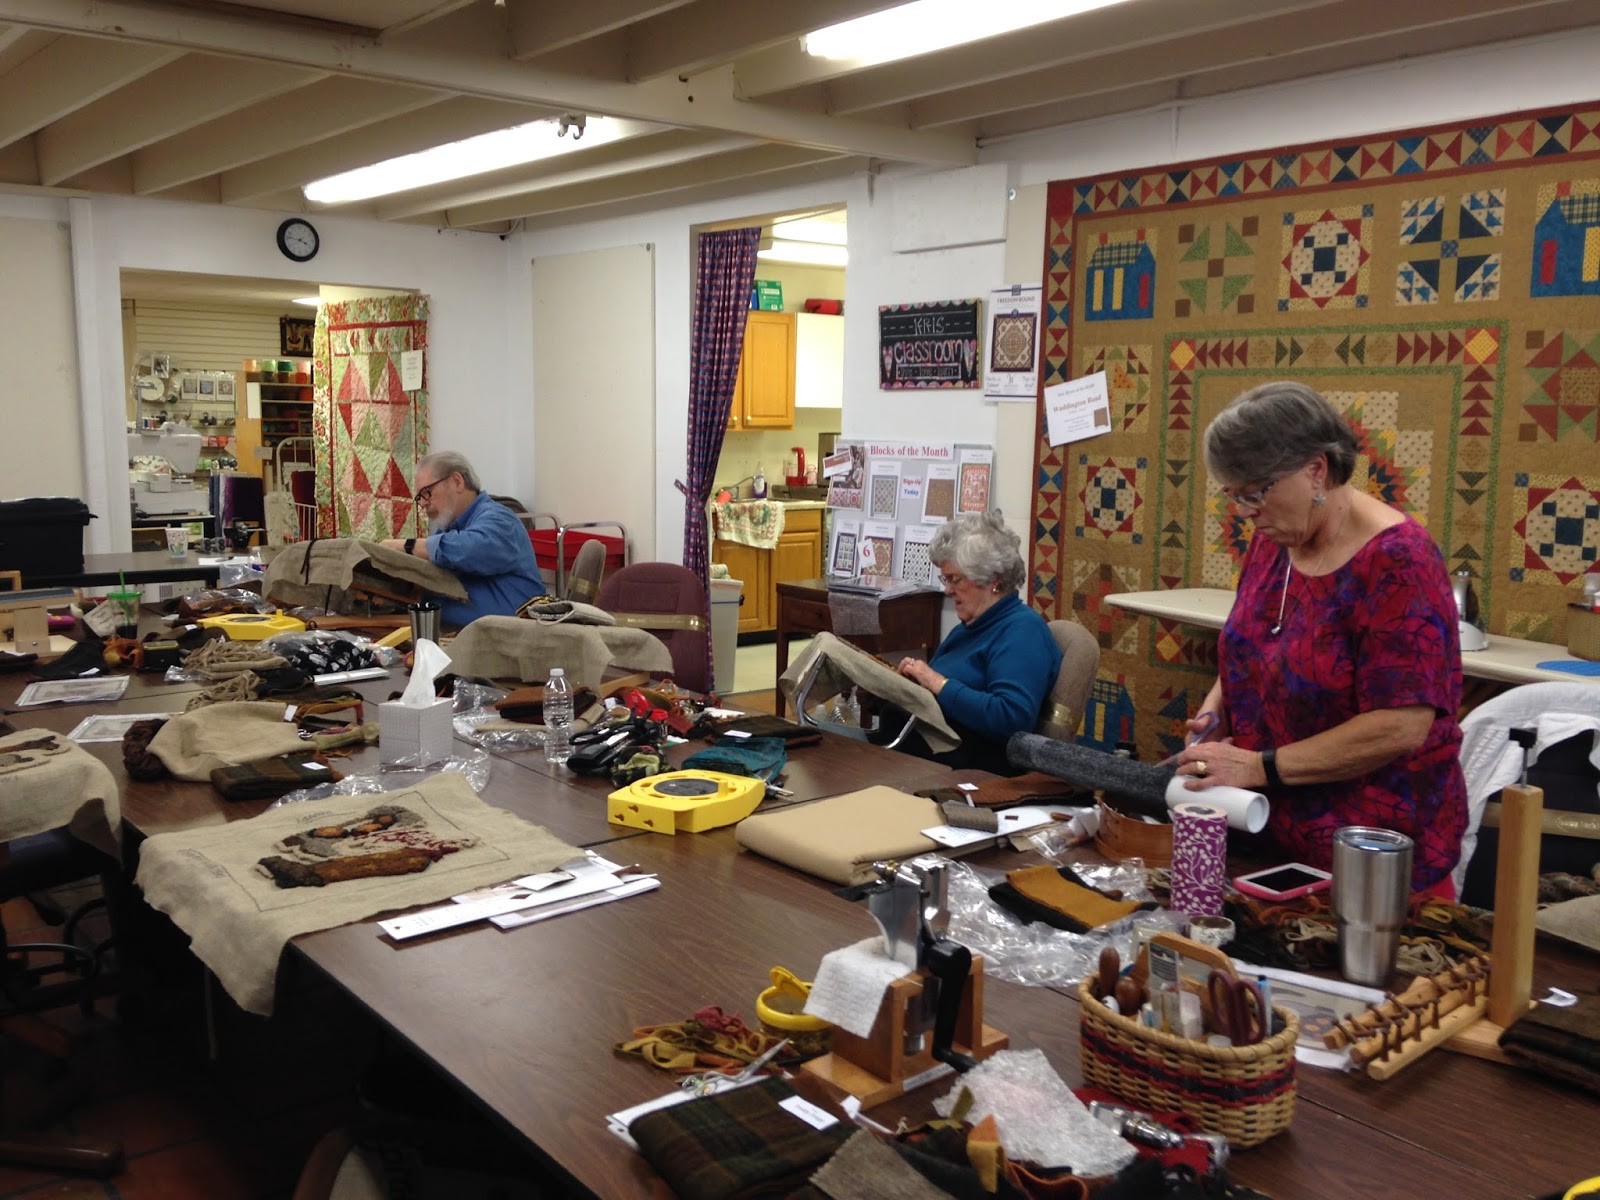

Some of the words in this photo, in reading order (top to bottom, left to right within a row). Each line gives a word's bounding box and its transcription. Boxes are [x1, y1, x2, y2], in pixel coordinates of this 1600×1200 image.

[1087, 393, 1102, 403] Road
[870, 445, 895, 456] Blocks
[897, 445, 906, 456] of
[907, 445, 920, 456] the
[921, 445, 949, 457] Month
[903, 478, 922, 486] Sign-Up
[904, 488, 919, 496] Today
[863, 544, 871, 558] 6
